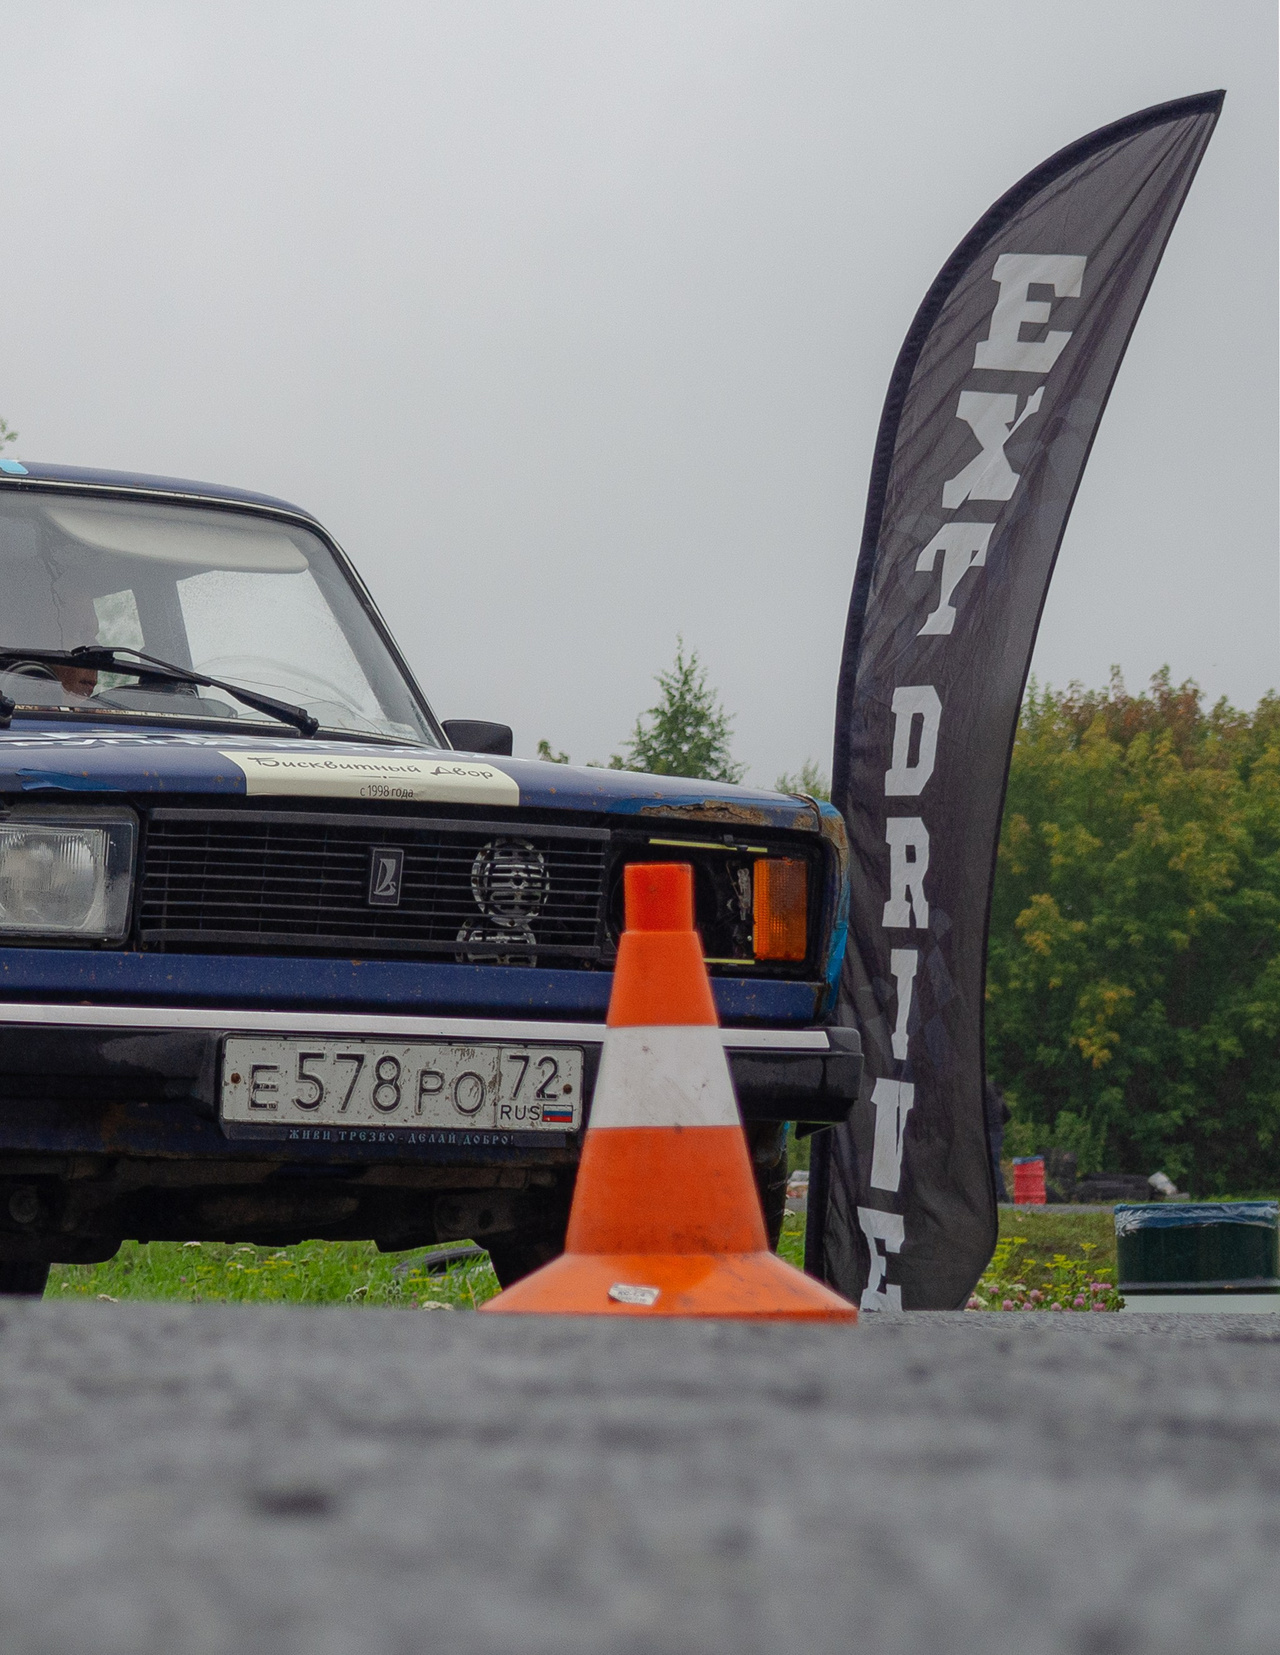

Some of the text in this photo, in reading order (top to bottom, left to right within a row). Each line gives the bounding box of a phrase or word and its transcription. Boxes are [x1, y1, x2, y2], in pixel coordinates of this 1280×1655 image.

[915, 253, 1088, 637] EXT
[247, 756, 494, 780] Бисквитный Двор
[367, 785, 390, 798] 1998
[391, 787, 415, 799] года
[507, 1055, 559, 1100] 72
[500, 1104, 540, 1121] RUS
[289, 1129, 331, 1140] ЖИВИ
[463, 1133, 515, 1145] ДОБРО!
